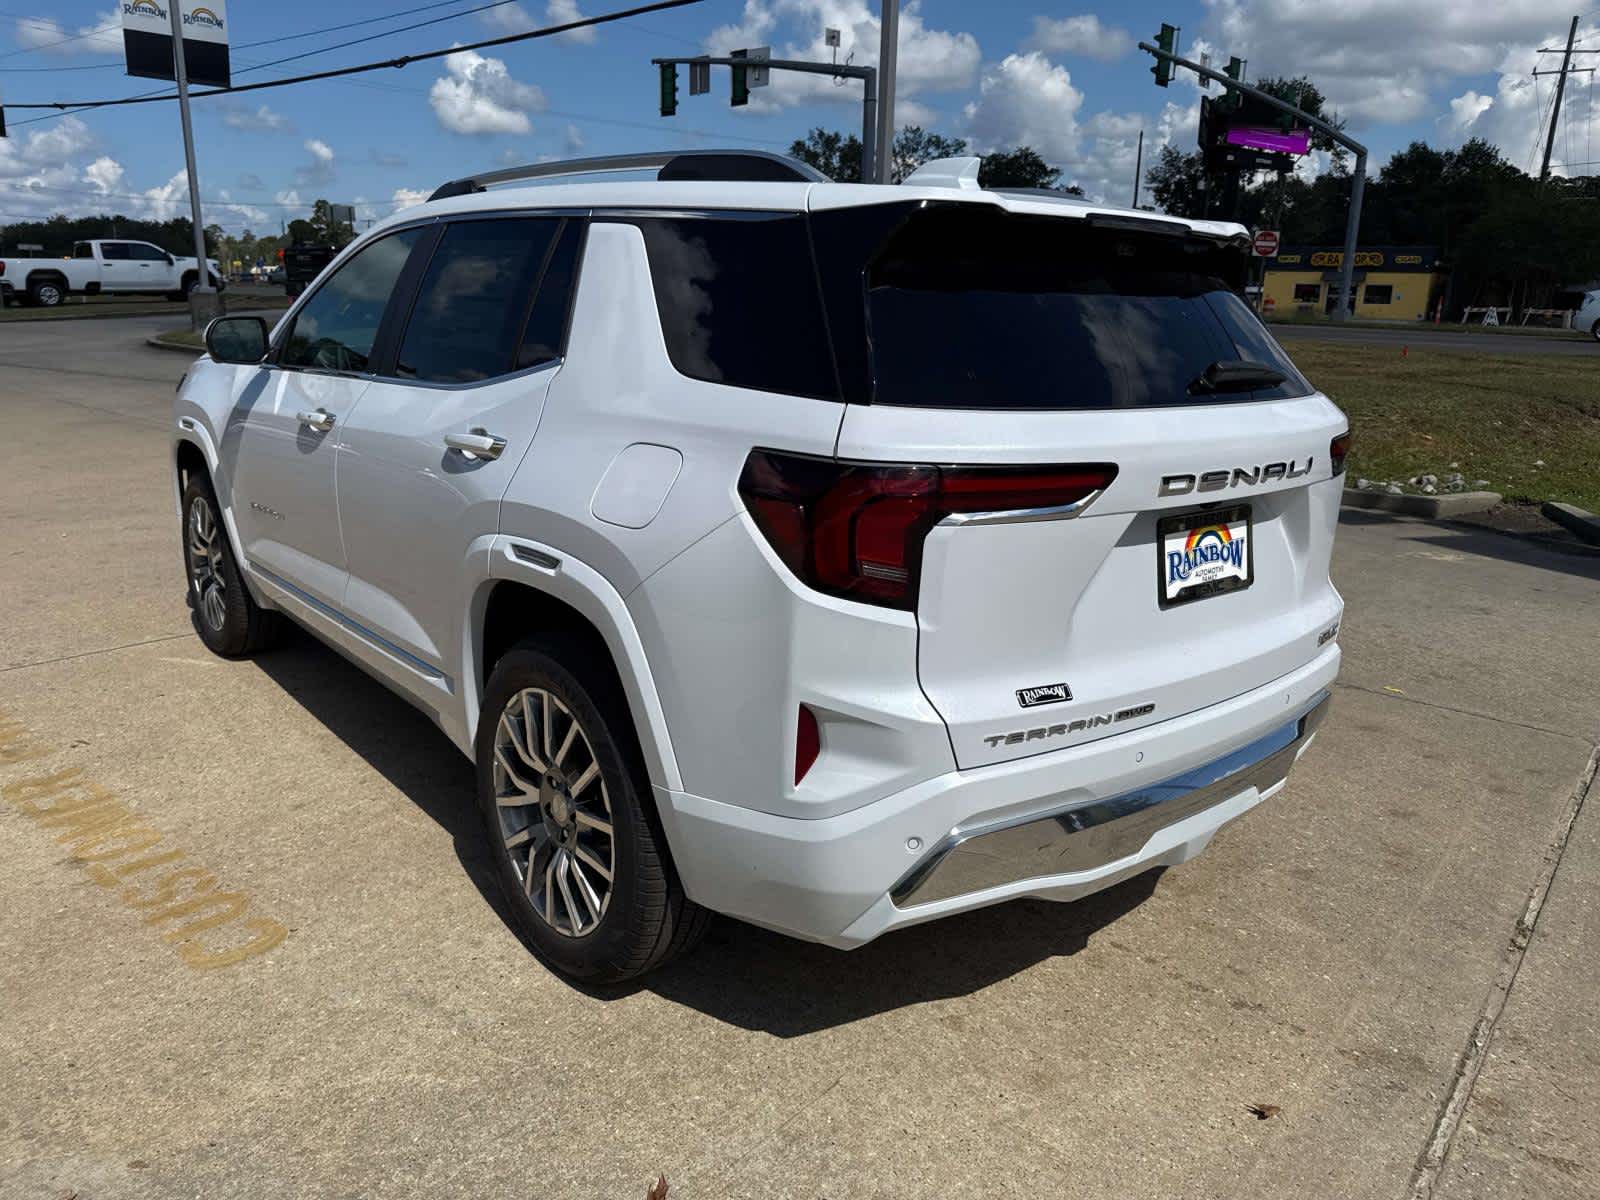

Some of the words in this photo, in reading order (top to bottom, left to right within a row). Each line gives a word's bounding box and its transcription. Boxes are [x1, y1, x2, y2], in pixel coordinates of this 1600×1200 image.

[123, 3, 167, 21] RAINBOW
[182, 13, 224, 30] RAINBOW
[1157, 455, 1314, 498] DENALI
[1167, 536, 1245, 587] RAINBOW
[1021, 685, 1067, 705] RAINBOW
[983, 713, 1113, 748] TERRAIN
[1114, 703, 1156, 722] AWD
